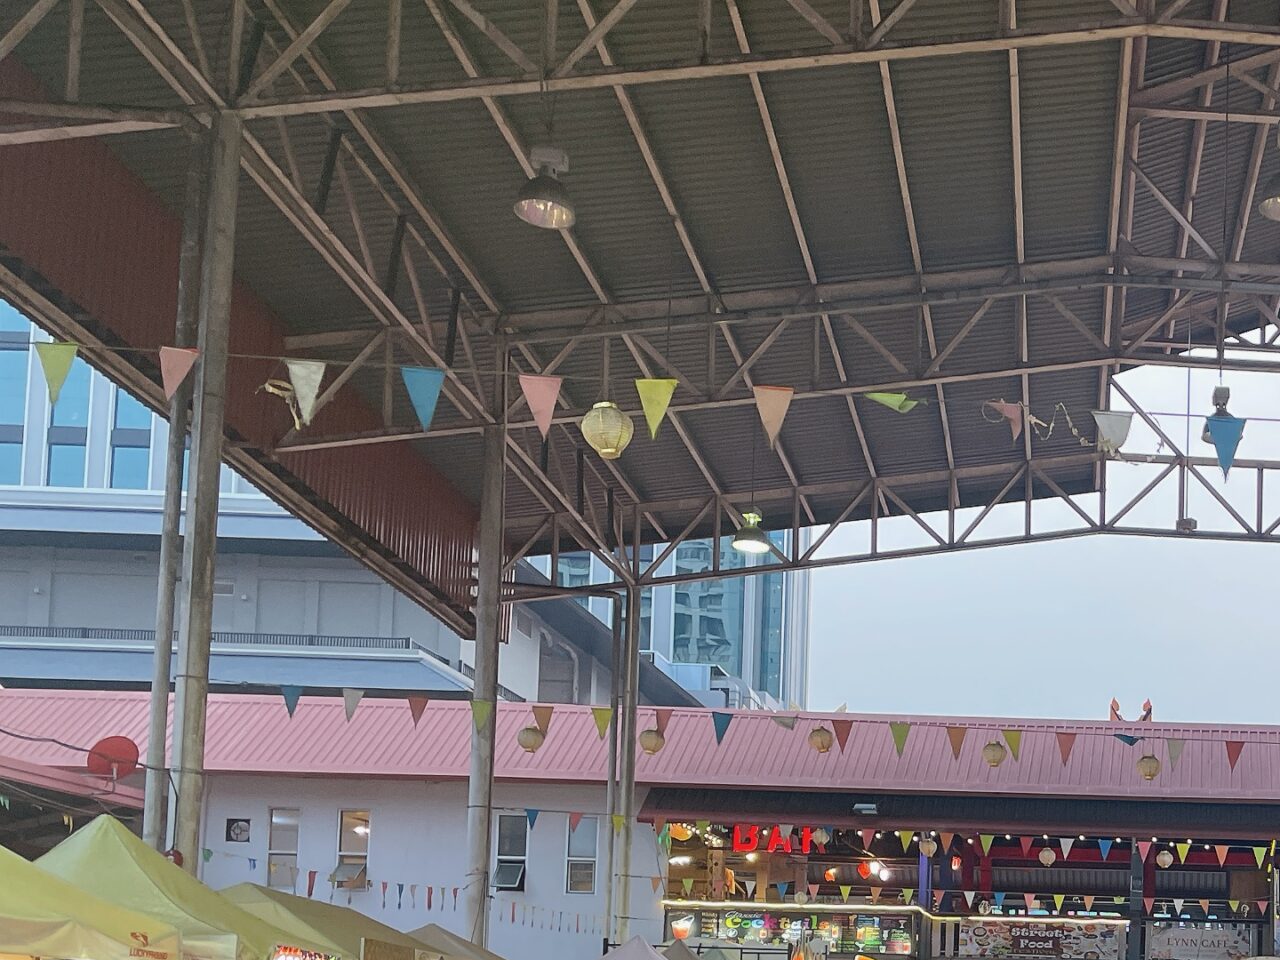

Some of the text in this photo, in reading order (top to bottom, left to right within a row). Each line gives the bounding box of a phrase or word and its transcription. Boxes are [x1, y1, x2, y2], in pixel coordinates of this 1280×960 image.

[725, 913, 830, 929] Cocktails
[1020, 939, 1054, 949] Food
[1168, 938, 1198, 948] LYNN
